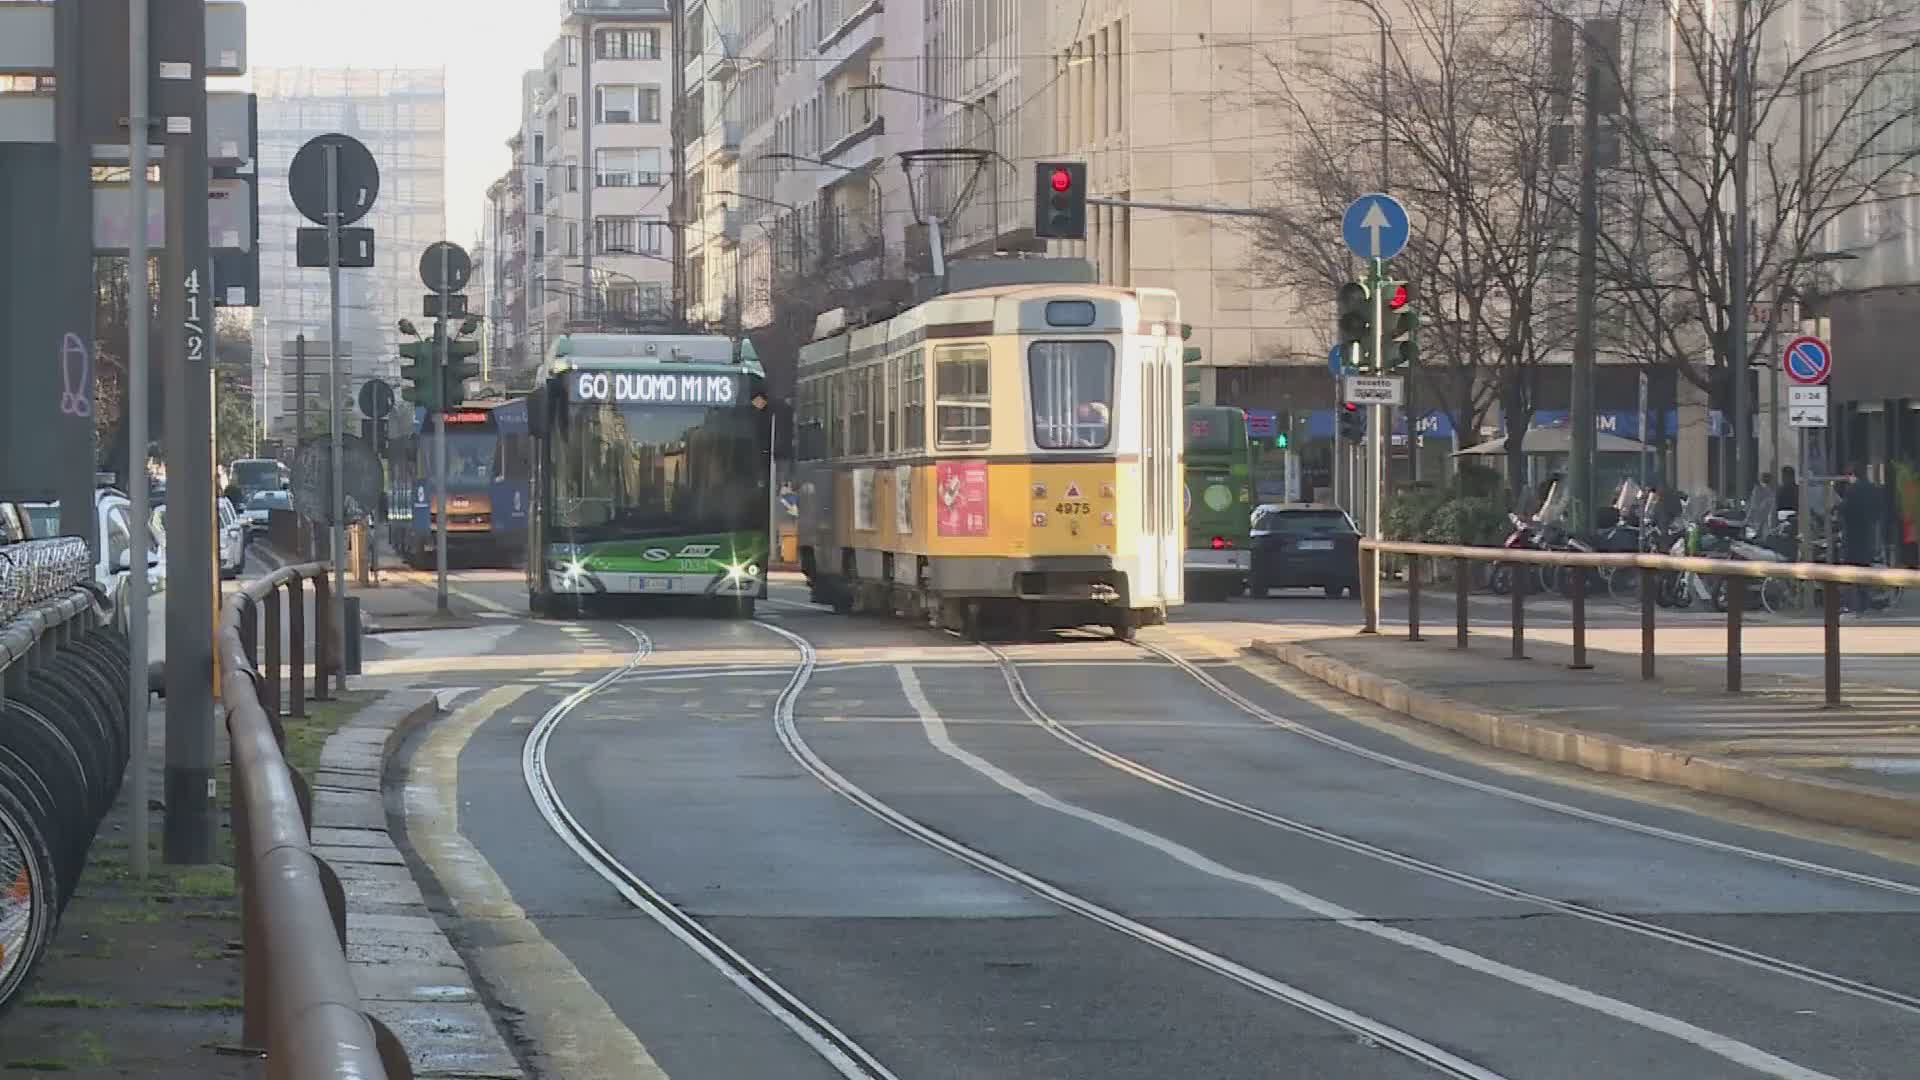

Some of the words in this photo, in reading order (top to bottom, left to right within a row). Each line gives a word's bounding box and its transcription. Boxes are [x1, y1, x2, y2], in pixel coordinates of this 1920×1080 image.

[579, 373, 608, 400] 60
[615, 373, 677, 401] DUOMO
[681, 374, 702, 402] M1
[706, 376, 732, 402] M3
[1055, 502, 1091, 515] 4975
